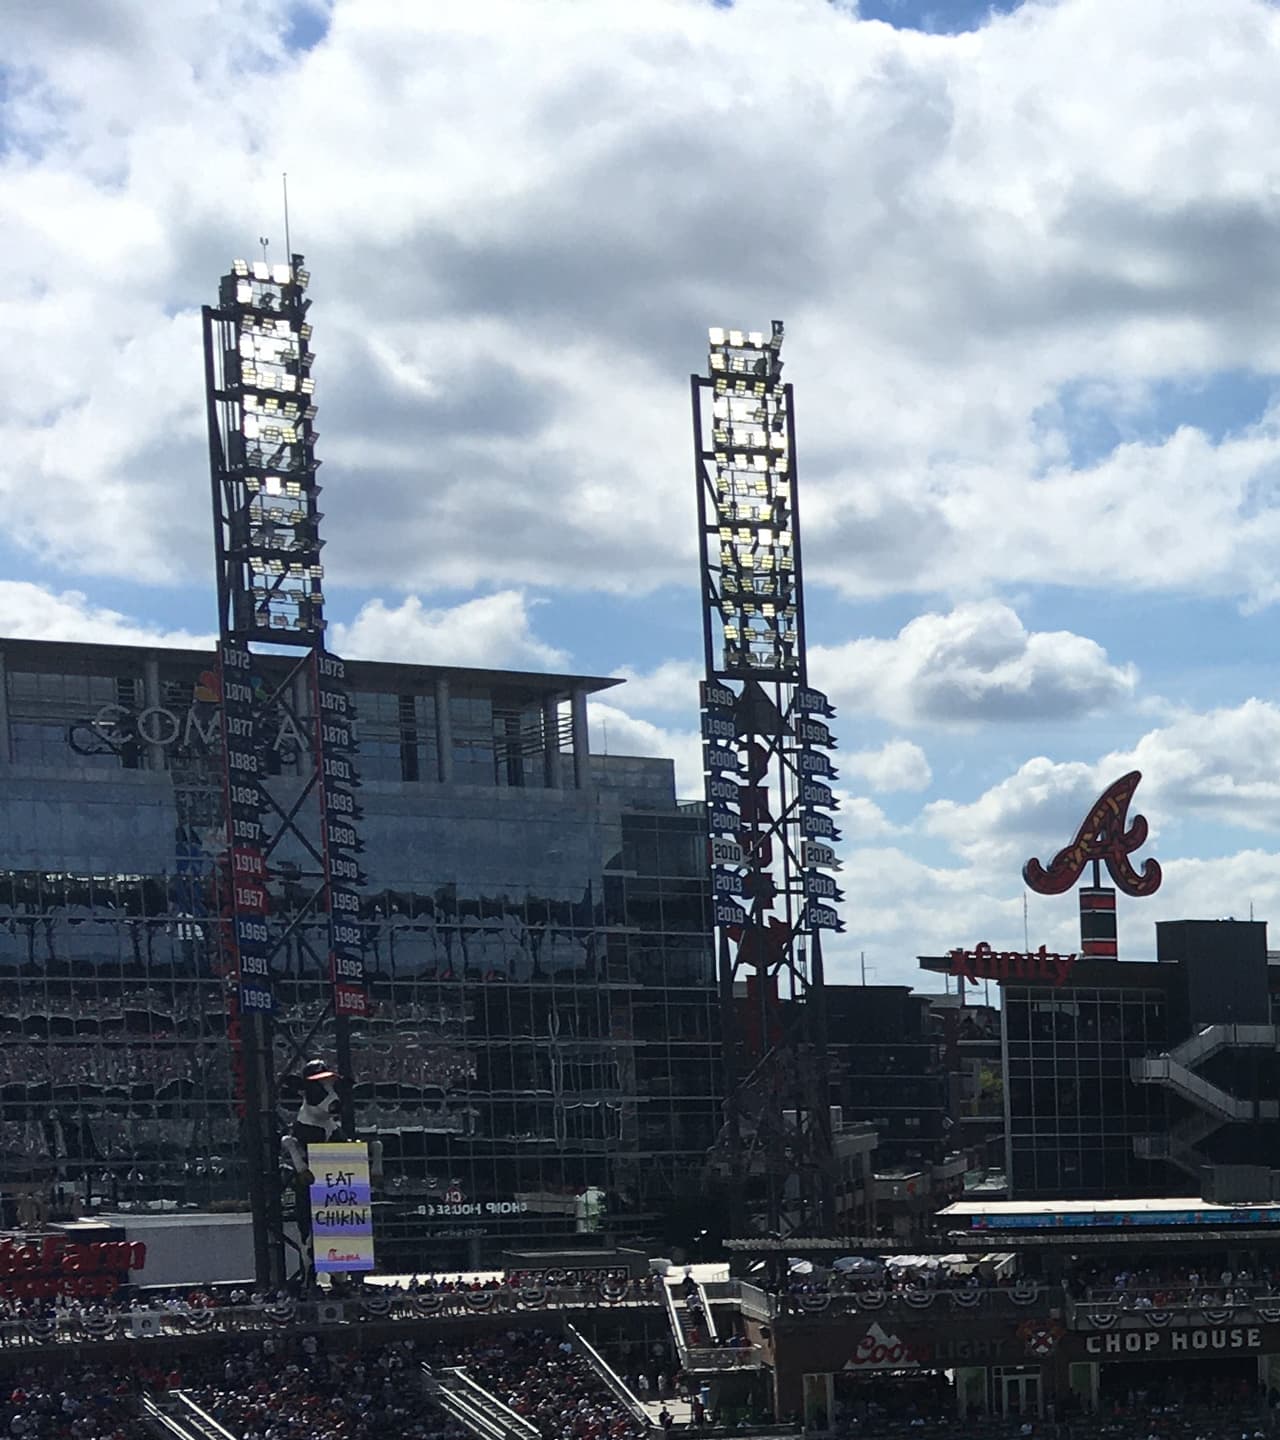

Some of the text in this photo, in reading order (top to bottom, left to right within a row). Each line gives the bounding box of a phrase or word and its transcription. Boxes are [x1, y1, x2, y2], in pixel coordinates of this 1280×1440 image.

[319, 657, 344, 678] 1873
[321, 691, 346, 712] 1875
[707, 687, 733, 707] 1996
[799, 692, 825, 710] 1997
[228, 716, 253, 737] 1877
[708, 718, 735, 738] 1998
[800, 722, 828, 741] 1999
[324, 758, 350, 779] 1891
[709, 750, 737, 770] 2000
[802, 754, 828, 773] 2001
[231, 785, 260, 806] 1892
[711, 781, 739, 800] 2002
[804, 785, 831, 803] 2003
[327, 792, 353, 812] 1893
[233, 819, 260, 840] 1897
[712, 812, 741, 831] 2004
[805, 816, 832, 834] 2005
[714, 843, 741, 861] 2010
[807, 847, 832, 865] 2012
[235, 854, 262, 874] 1914
[716, 874, 743, 893] 2013
[808, 877, 834, 896] 2018
[236, 888, 263, 907] 1957
[332, 891, 359, 912] 1958
[718, 905, 744, 924] 2019
[809, 908, 836, 926] 2020
[239, 922, 268, 942] 1969
[241, 956, 269, 976] 1991
[336, 959, 363, 978] 1992
[243, 989, 272, 1009] 1993
[338, 991, 365, 1010] 1995
[325, 1171, 354, 1188] EAT
[325, 1190, 358, 1207] MOR
[316, 1209, 366, 1226] CHIKIN
[1086, 1328, 1262, 1353] CHOP HOUSE
